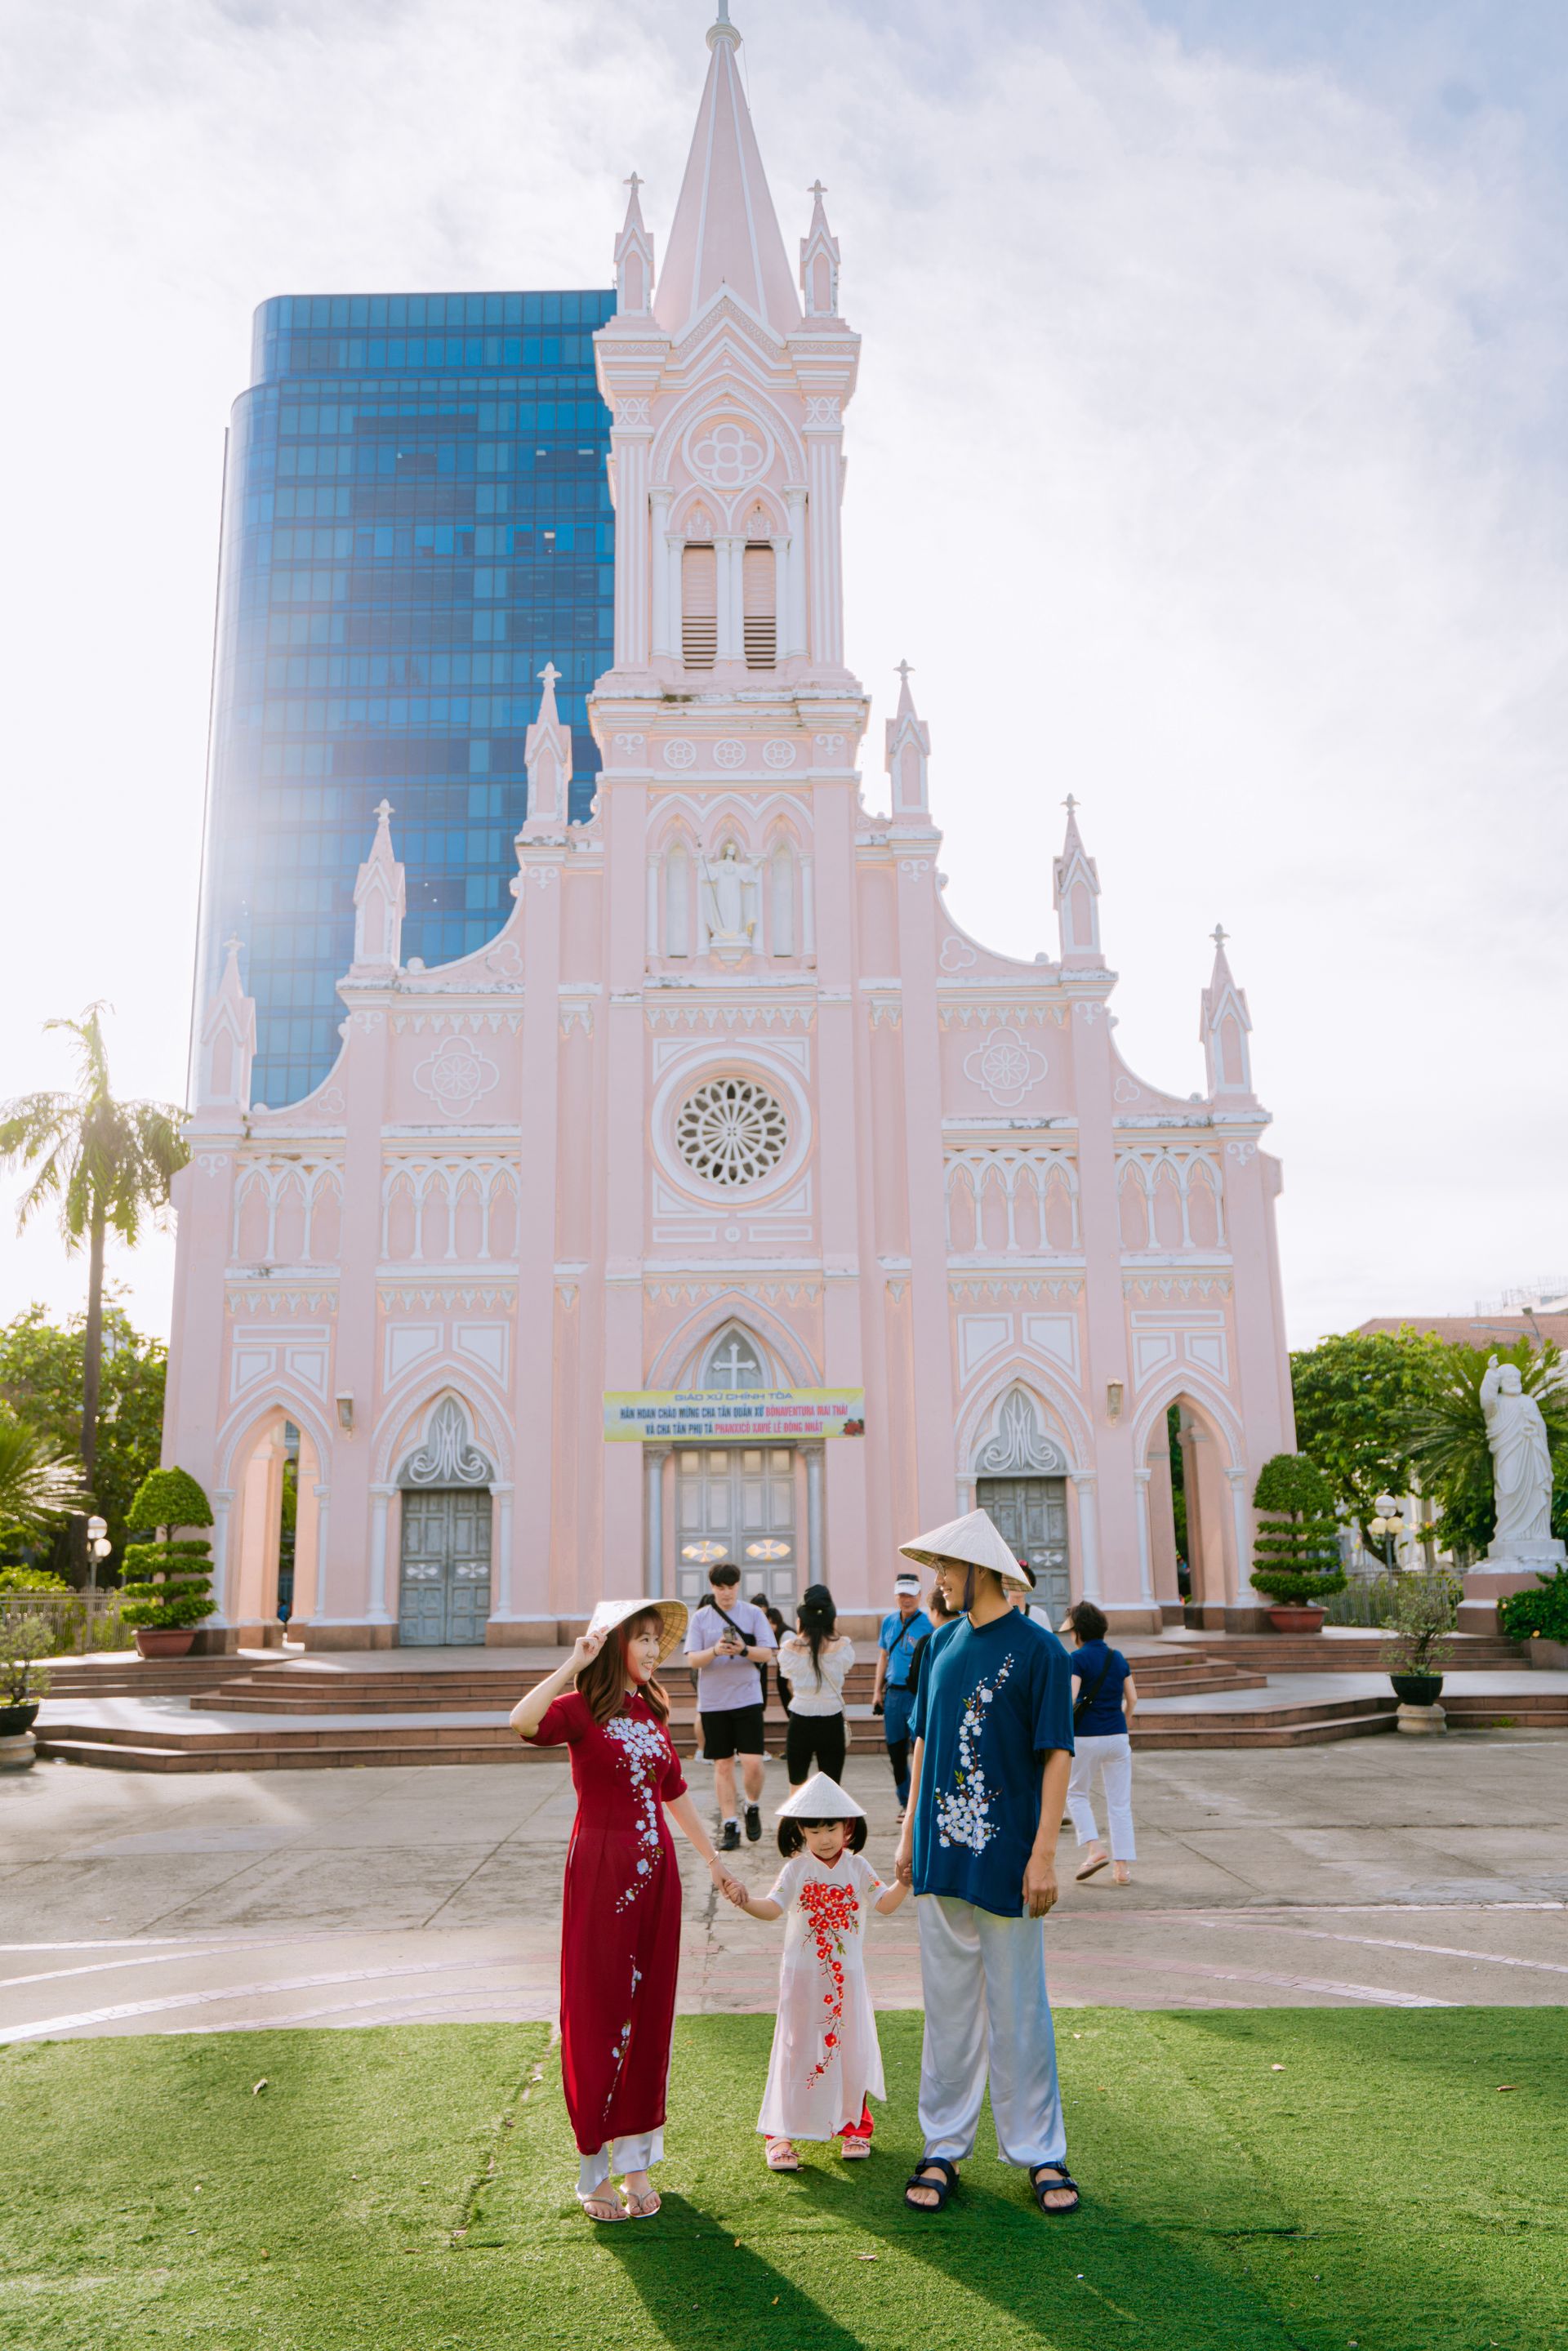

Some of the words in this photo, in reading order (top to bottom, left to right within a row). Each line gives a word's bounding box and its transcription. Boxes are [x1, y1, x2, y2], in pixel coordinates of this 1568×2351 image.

[675, 1391, 703, 1401] GIÁO
[636, 1408, 656, 1418] HOAN
[702, 1407, 715, 1418] CHA
[817, 1405, 831, 1416] MAI
[657, 1424, 670, 1435] CHA
